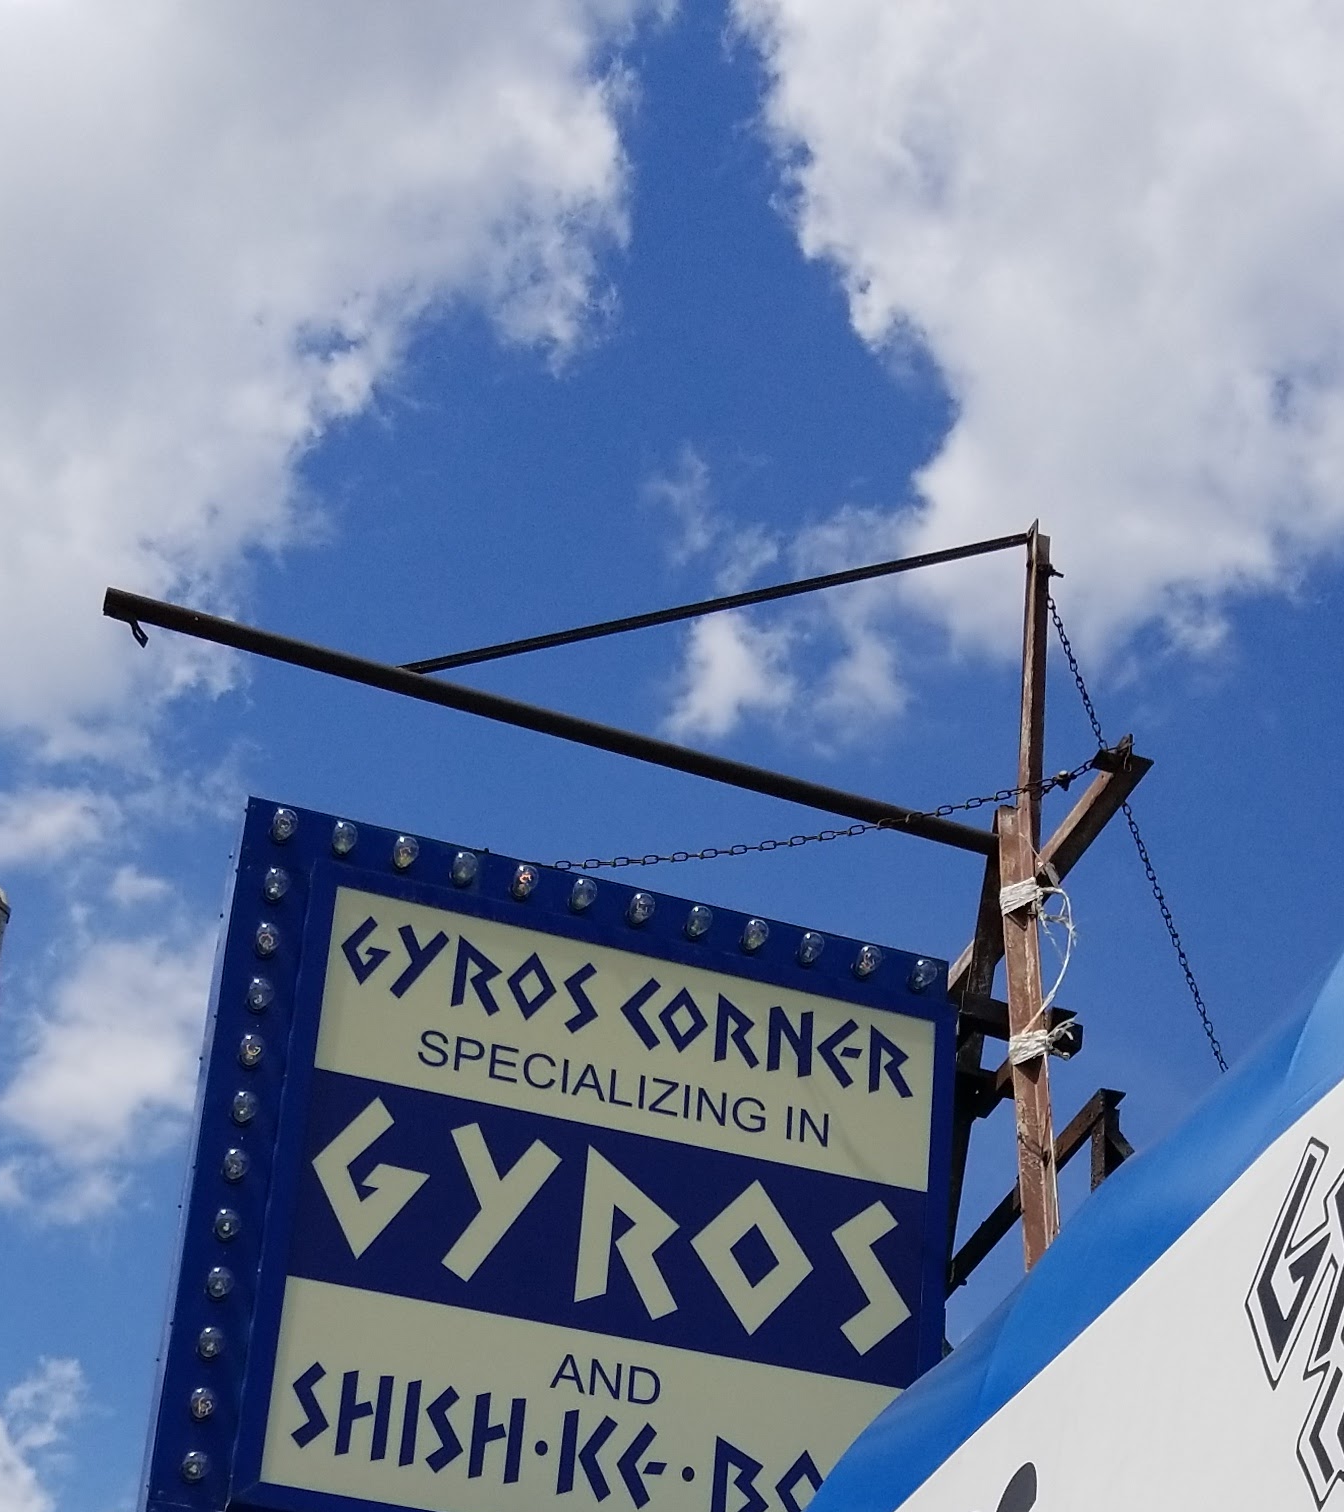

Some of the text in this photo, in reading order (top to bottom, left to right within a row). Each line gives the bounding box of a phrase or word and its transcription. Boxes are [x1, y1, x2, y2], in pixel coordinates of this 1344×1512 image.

[341, 915, 914, 1098] GYROS CORNER
[418, 1030, 830, 1148] SPECIALIZING IN
[311, 1097, 913, 1356] GYROS
[550, 1353, 661, 1405] AND
